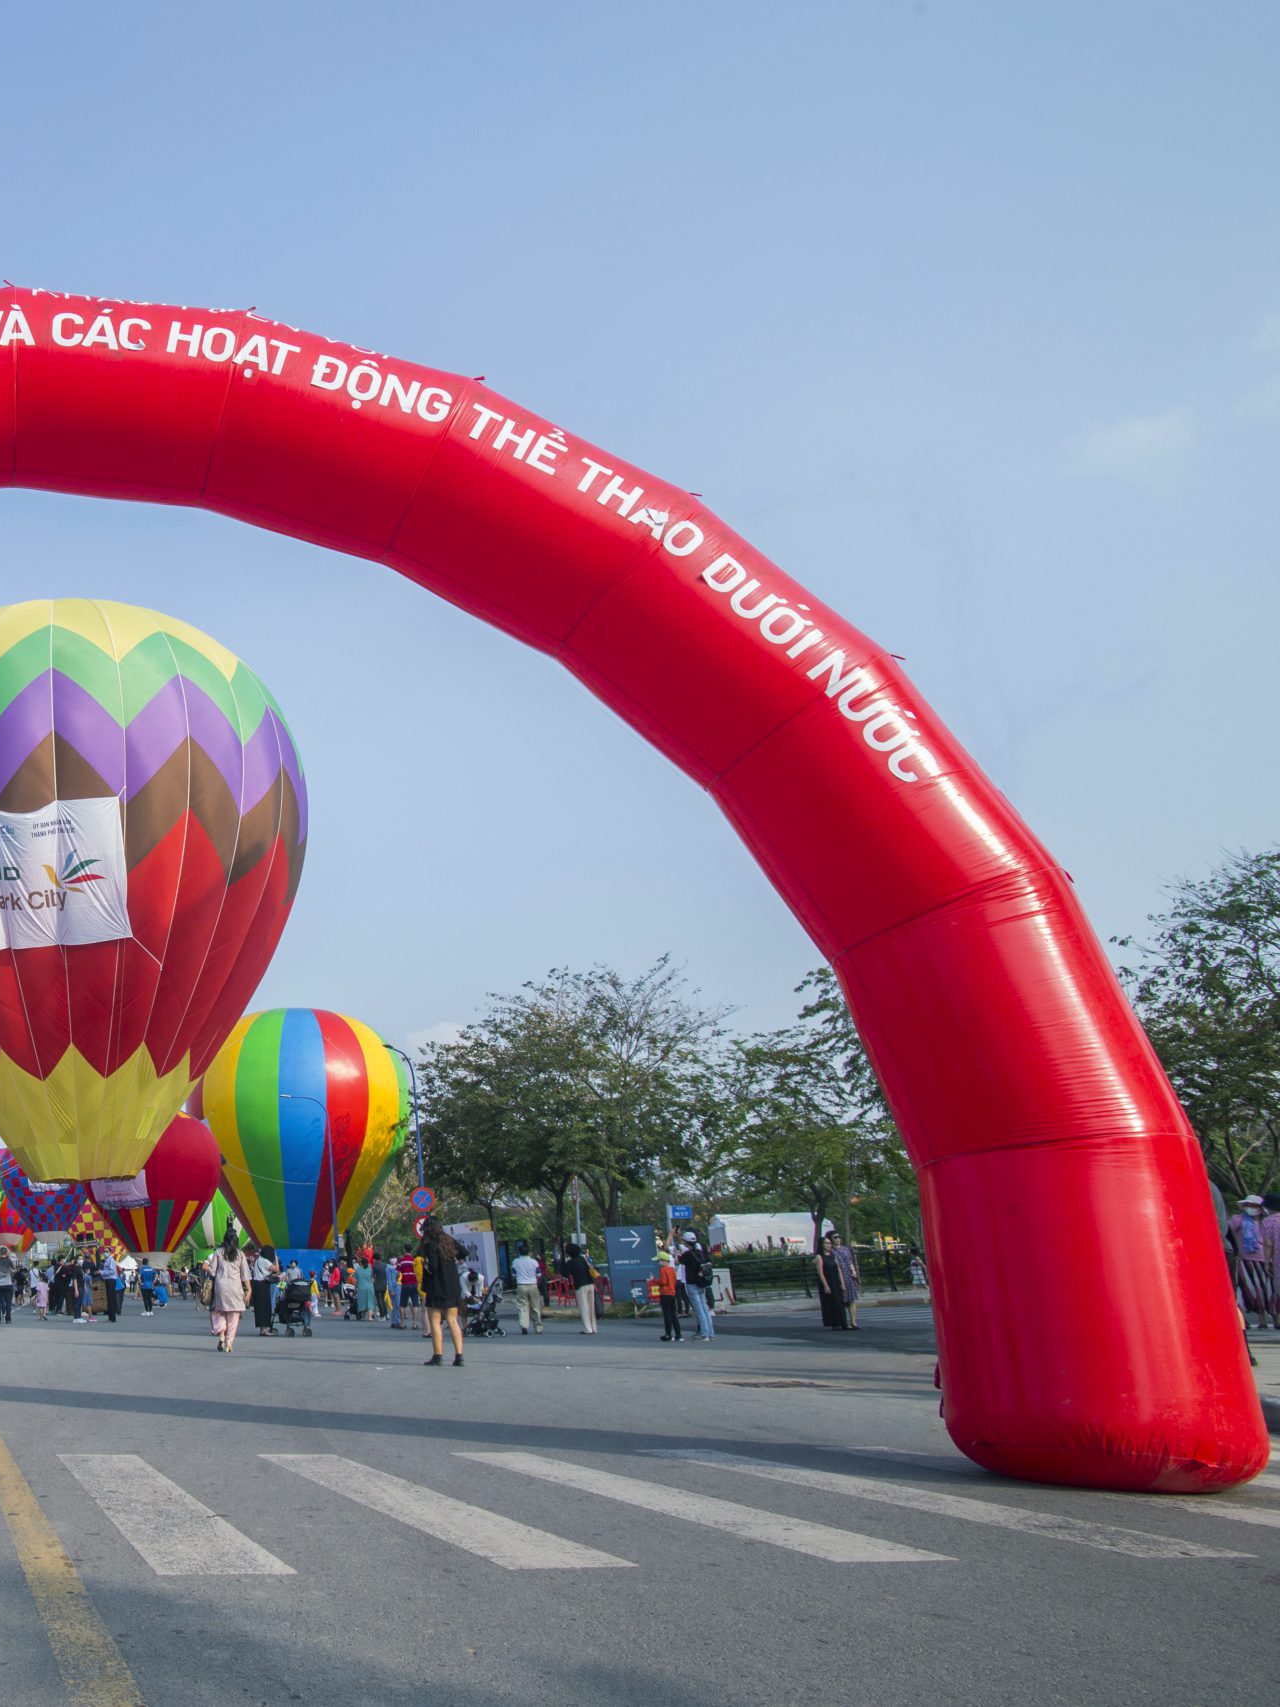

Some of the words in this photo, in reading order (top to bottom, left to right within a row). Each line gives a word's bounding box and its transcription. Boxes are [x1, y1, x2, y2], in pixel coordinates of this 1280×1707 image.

[52, 308, 152, 351] CÁC
[166, 321, 301, 378] HOẠT
[310, 355, 453, 423] ĐỘNG
[469, 403, 569, 476] THỂ
[577, 456, 705, 557] THAO
[701, 553, 824, 660] DƯỚI
[806, 649, 938, 783] NƯỚC
[27, 889, 69, 912] City
